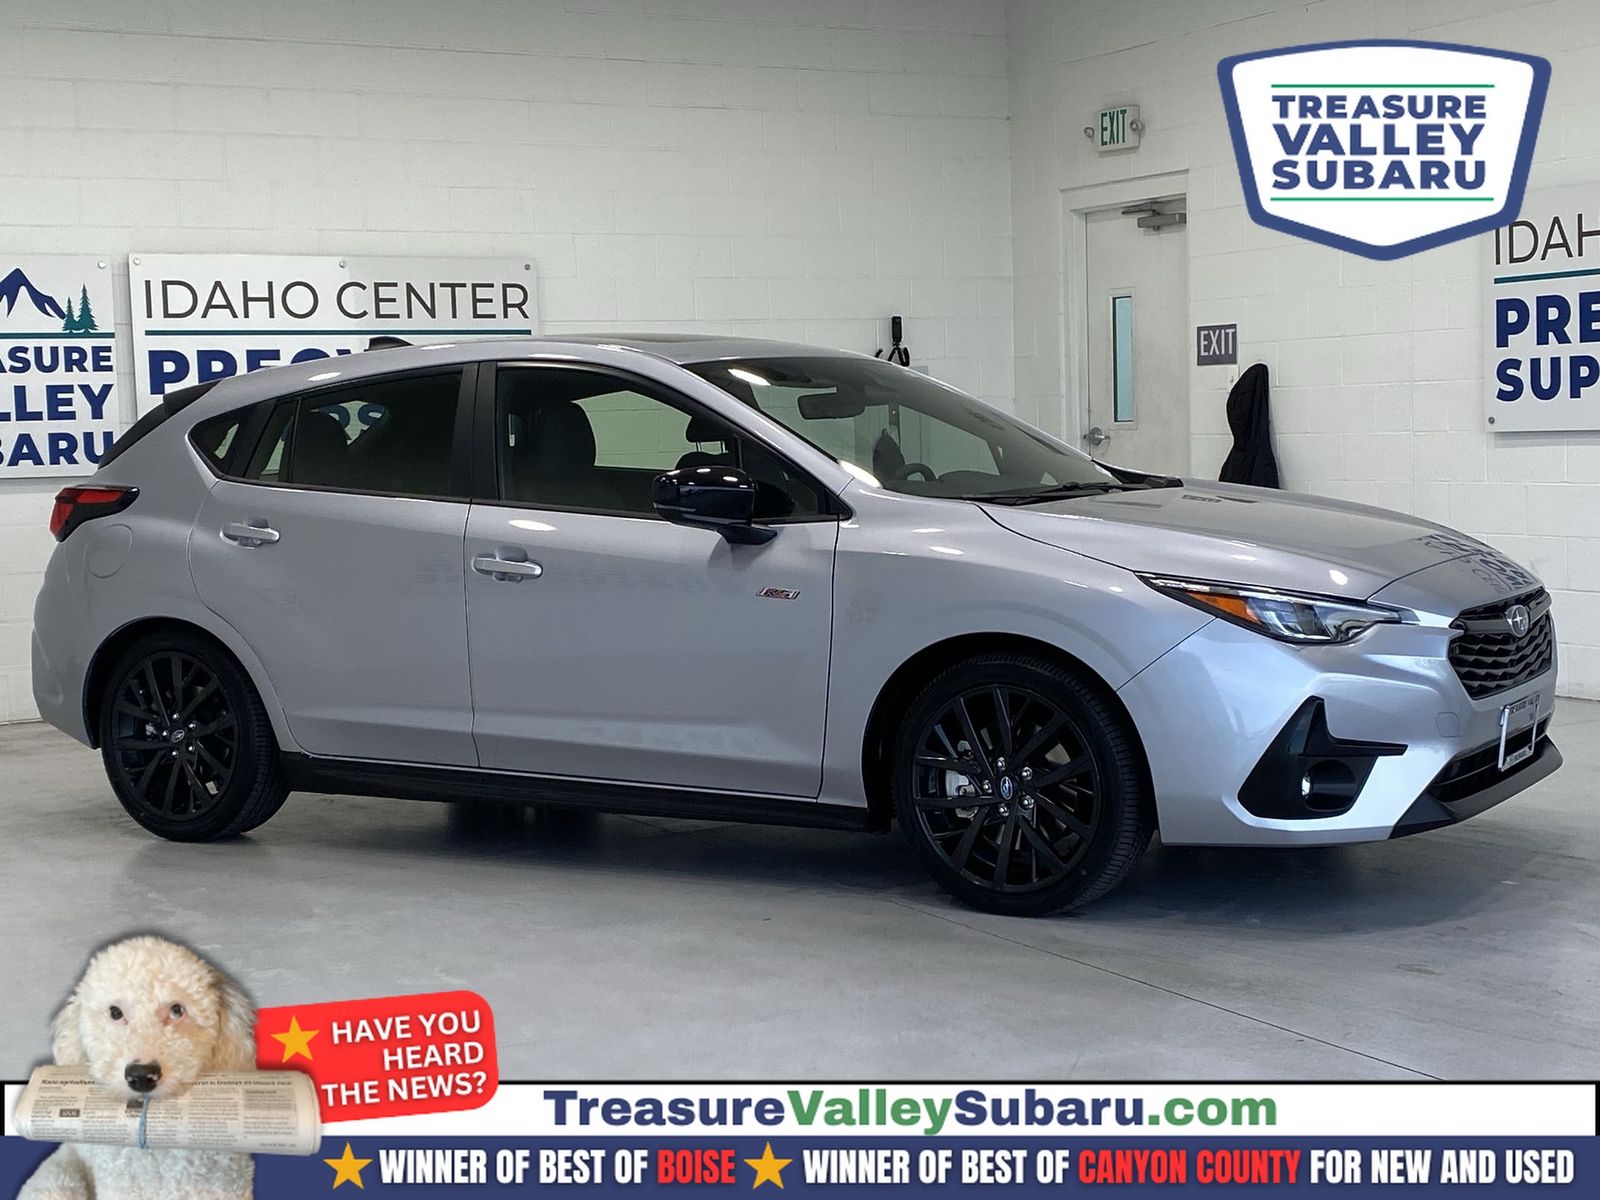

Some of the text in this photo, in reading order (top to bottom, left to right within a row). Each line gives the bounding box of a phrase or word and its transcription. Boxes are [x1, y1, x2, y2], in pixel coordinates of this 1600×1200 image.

[1100, 109, 1127, 146] EXIT
[144, 279, 530, 320] IDAHO CENTER
[0, 346, 114, 373] SURE
[1200, 329, 1236, 356] EXIT
[0, 431, 114, 467] ARU
